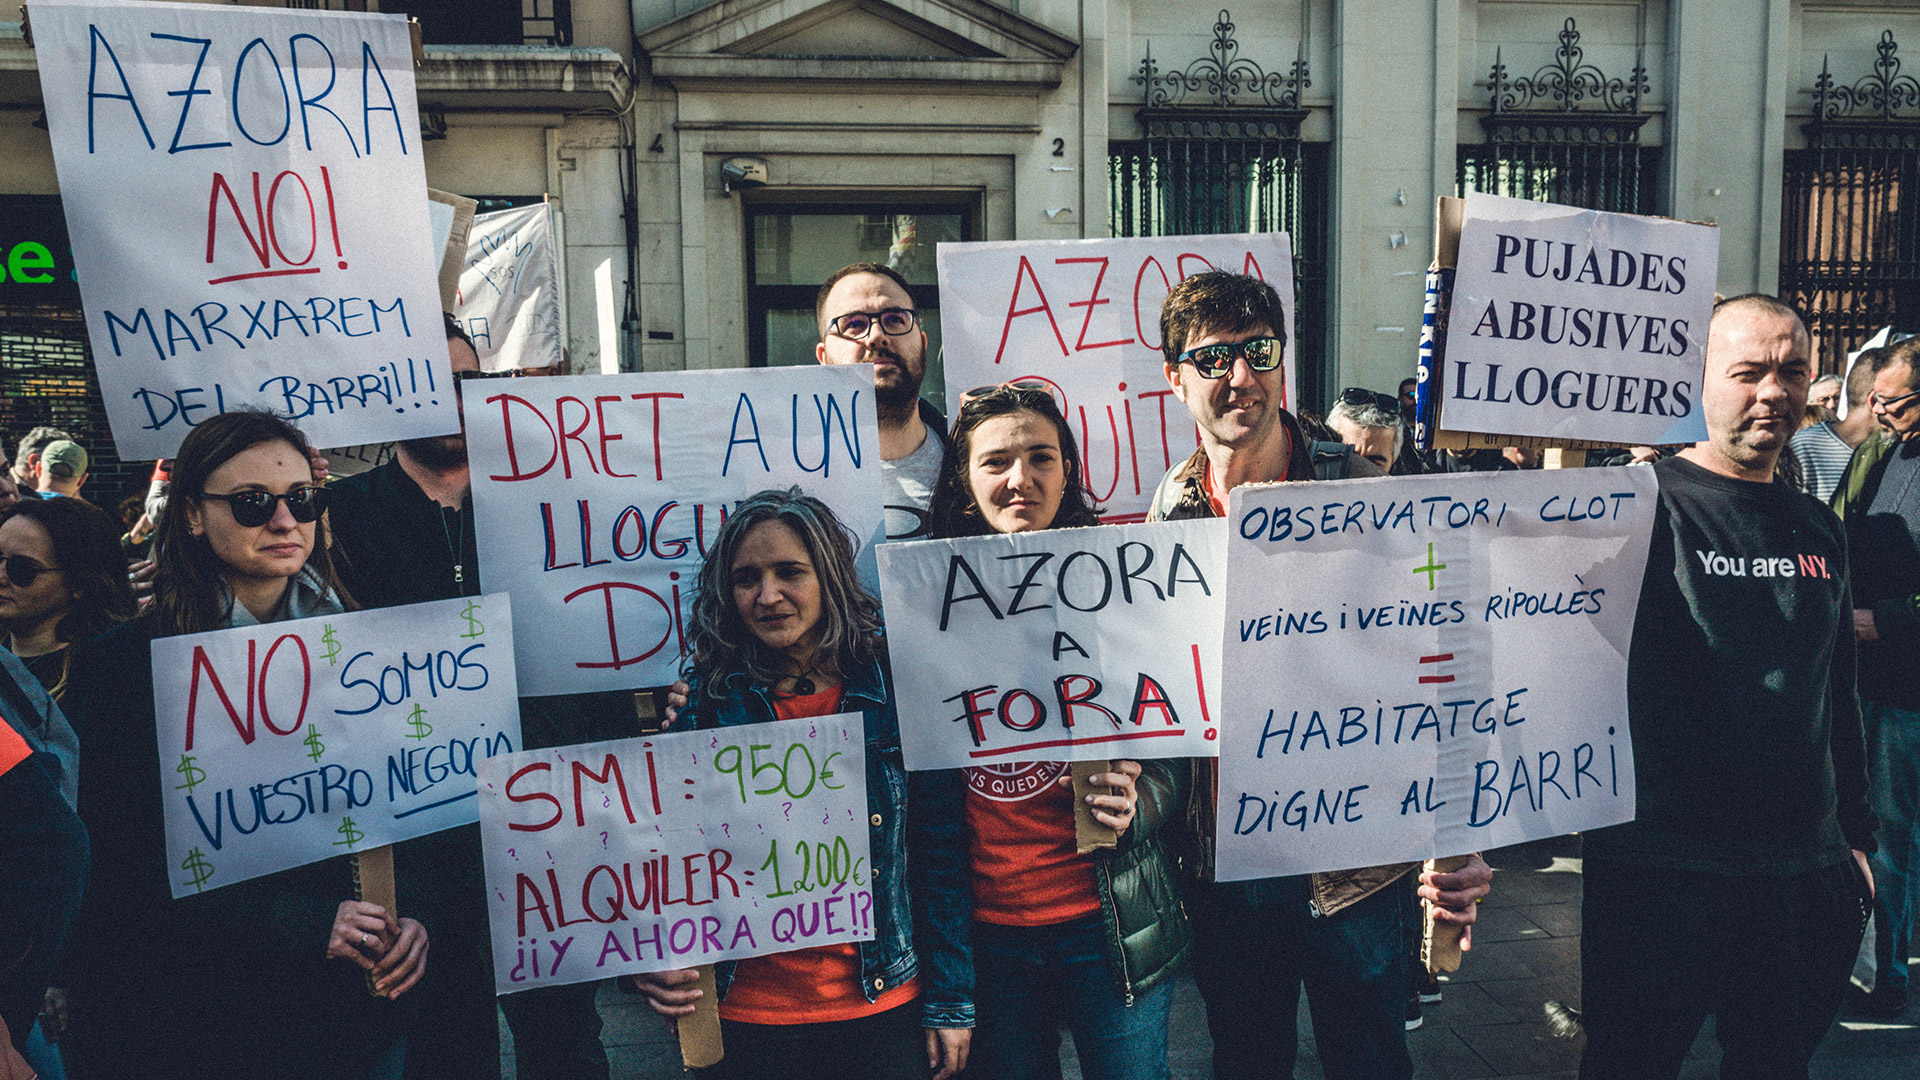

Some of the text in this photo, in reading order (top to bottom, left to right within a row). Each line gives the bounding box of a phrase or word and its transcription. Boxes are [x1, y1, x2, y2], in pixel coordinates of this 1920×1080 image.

[87, 24, 407, 158] AZORA
[1051, 137, 1065, 157] 2
[206, 166, 348, 270] NO!
[490, 265, 515, 279] SOS
[1492, 233, 1687, 295] PUJADES
[104, 297, 412, 361] MARXAREM
[995, 250, 1265, 364] AZO
[1471, 300, 1690, 357] ABUSIVES
[1452, 360, 1692, 418] LLOGUERS
[486, 390, 863, 482] DRET A UN
[540, 499, 745, 572] LLOGU
[1239, 492, 1636, 542] OBSERVATORI CLOT
[938, 541, 1212, 632] AZORA
[1696, 549, 1831, 581] You are NY.
[1052, 630, 1090, 662] A
[186, 633, 490, 752] NO SOMOS
[714, 742, 848, 804] 950€
[1400, 777, 1447, 817] AL
[187, 763, 374, 850] VUESTRO
[596, 914, 757, 968] AHORA
